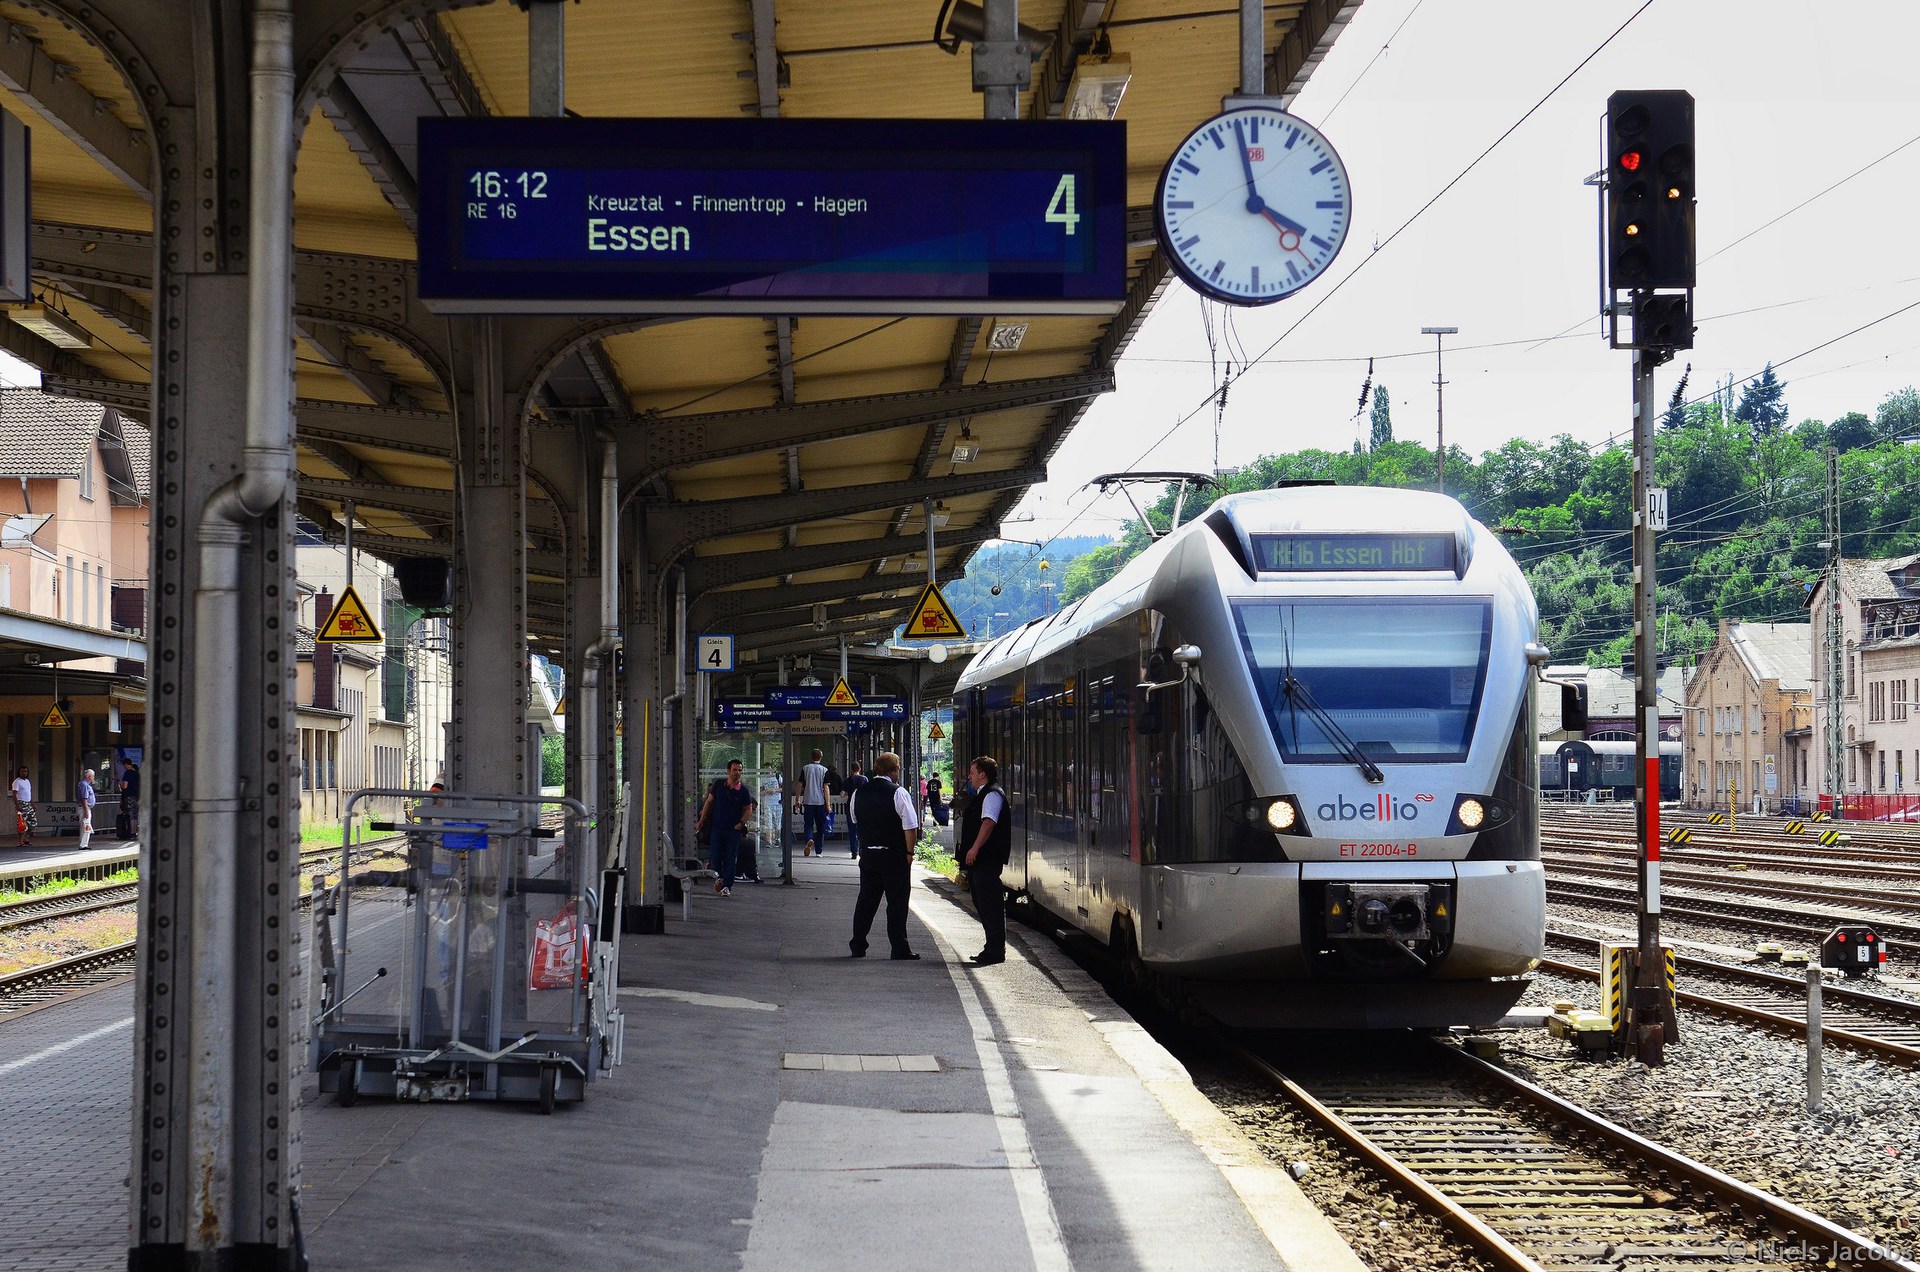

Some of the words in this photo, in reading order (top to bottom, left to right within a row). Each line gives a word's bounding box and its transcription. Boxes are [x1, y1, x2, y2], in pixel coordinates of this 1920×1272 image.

[469, 171, 548, 198] 16:12
[467, 202, 488, 219] RE
[498, 202, 518, 219] 16
[588, 194, 665, 212] Kreuztal
[692, 195, 787, 216] Finnentrop
[814, 196, 868, 217] Hagen
[1045, 174, 1081, 235] 4
[588, 218, 690, 251] Essen
[1649, 493, 1664, 526] R4
[1320, 541, 1382, 565] Essen
[1391, 540, 1425, 565] Hbf
[708, 648, 722, 667] 4
[718, 704, 724, 714] 3
[893, 704, 904, 713] 55
[802, 725, 829, 733] Gleisen
[46, 805, 77, 814] Zugang
[1317, 793, 1418, 822] abellio
[1340, 843, 1358, 857] ET
[1360, 843, 1418, 857] 22004-B
[1861, 949, 1866, 958] 5
